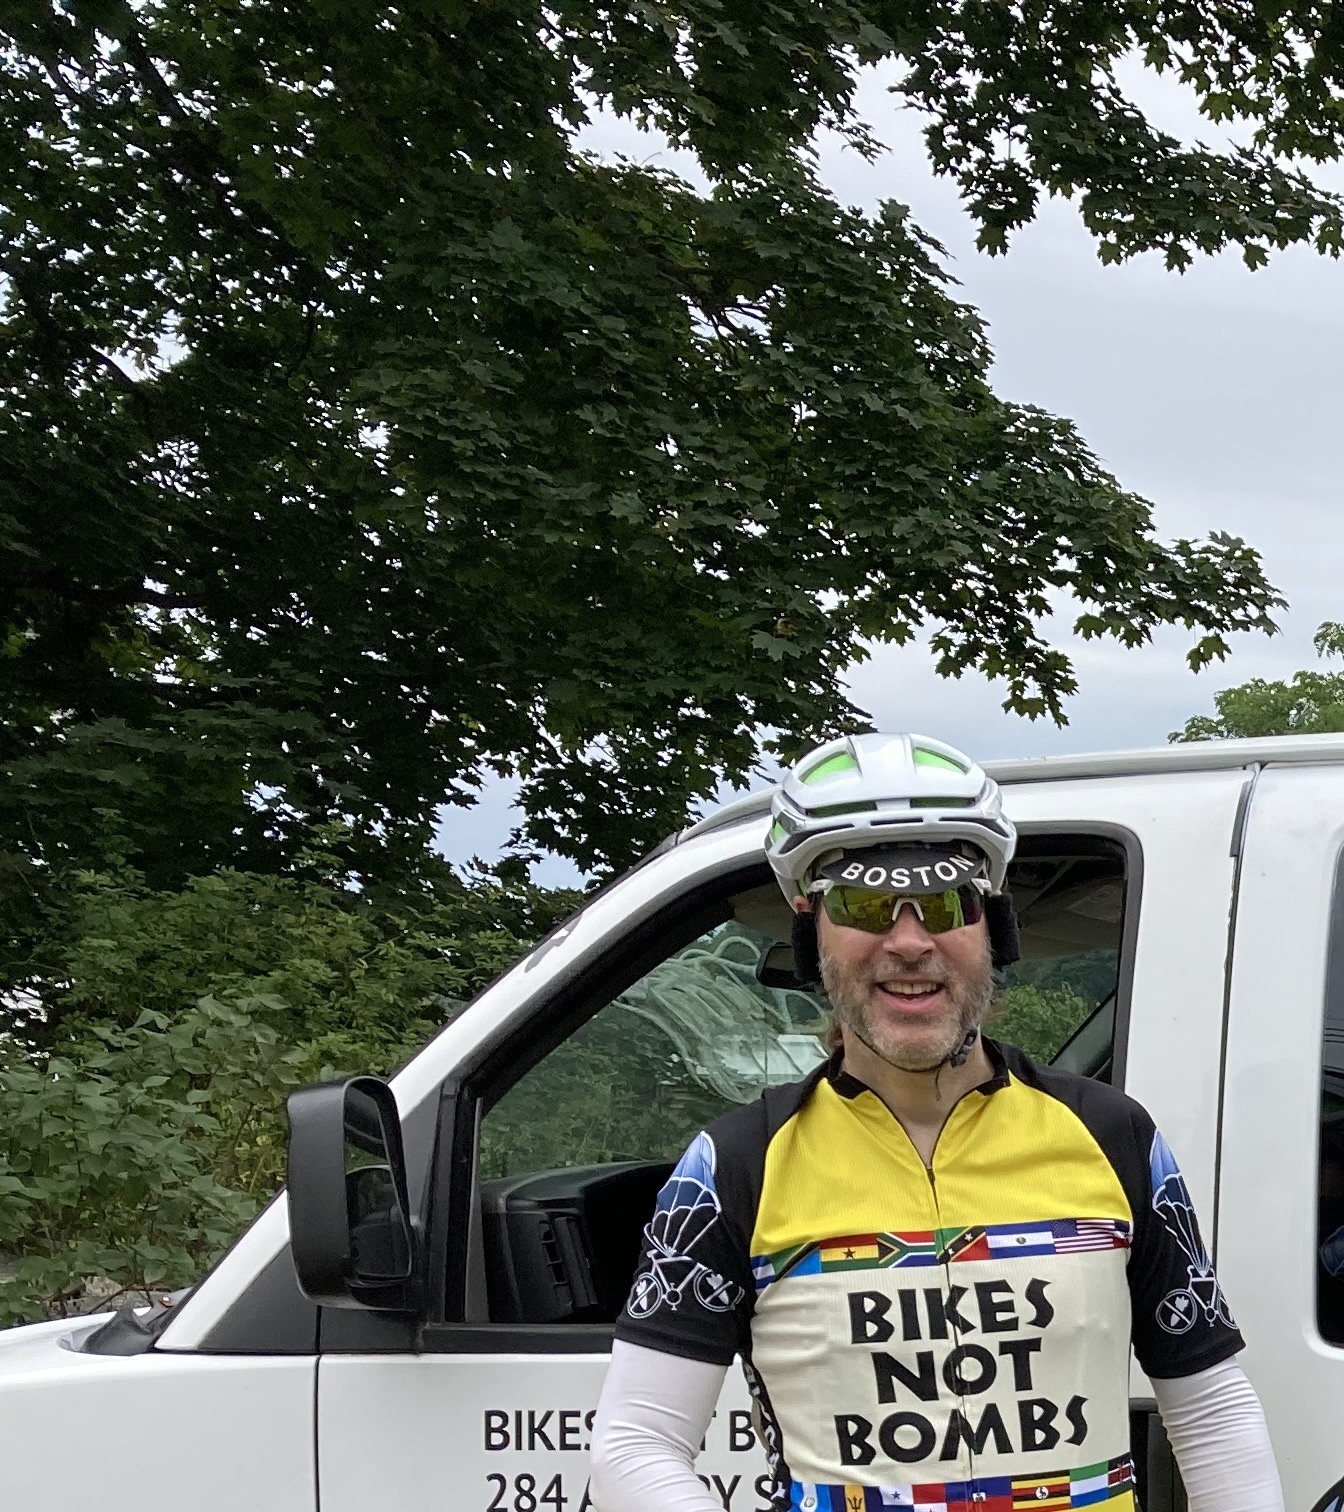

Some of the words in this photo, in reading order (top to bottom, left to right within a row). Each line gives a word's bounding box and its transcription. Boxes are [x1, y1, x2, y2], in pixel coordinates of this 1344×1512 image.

[841, 854, 975, 888] BOSTON
[847, 1277, 1055, 1344] BIKES
[870, 1337, 1042, 1404] NOT
[834, 1394, 1089, 1466] BOMBS
